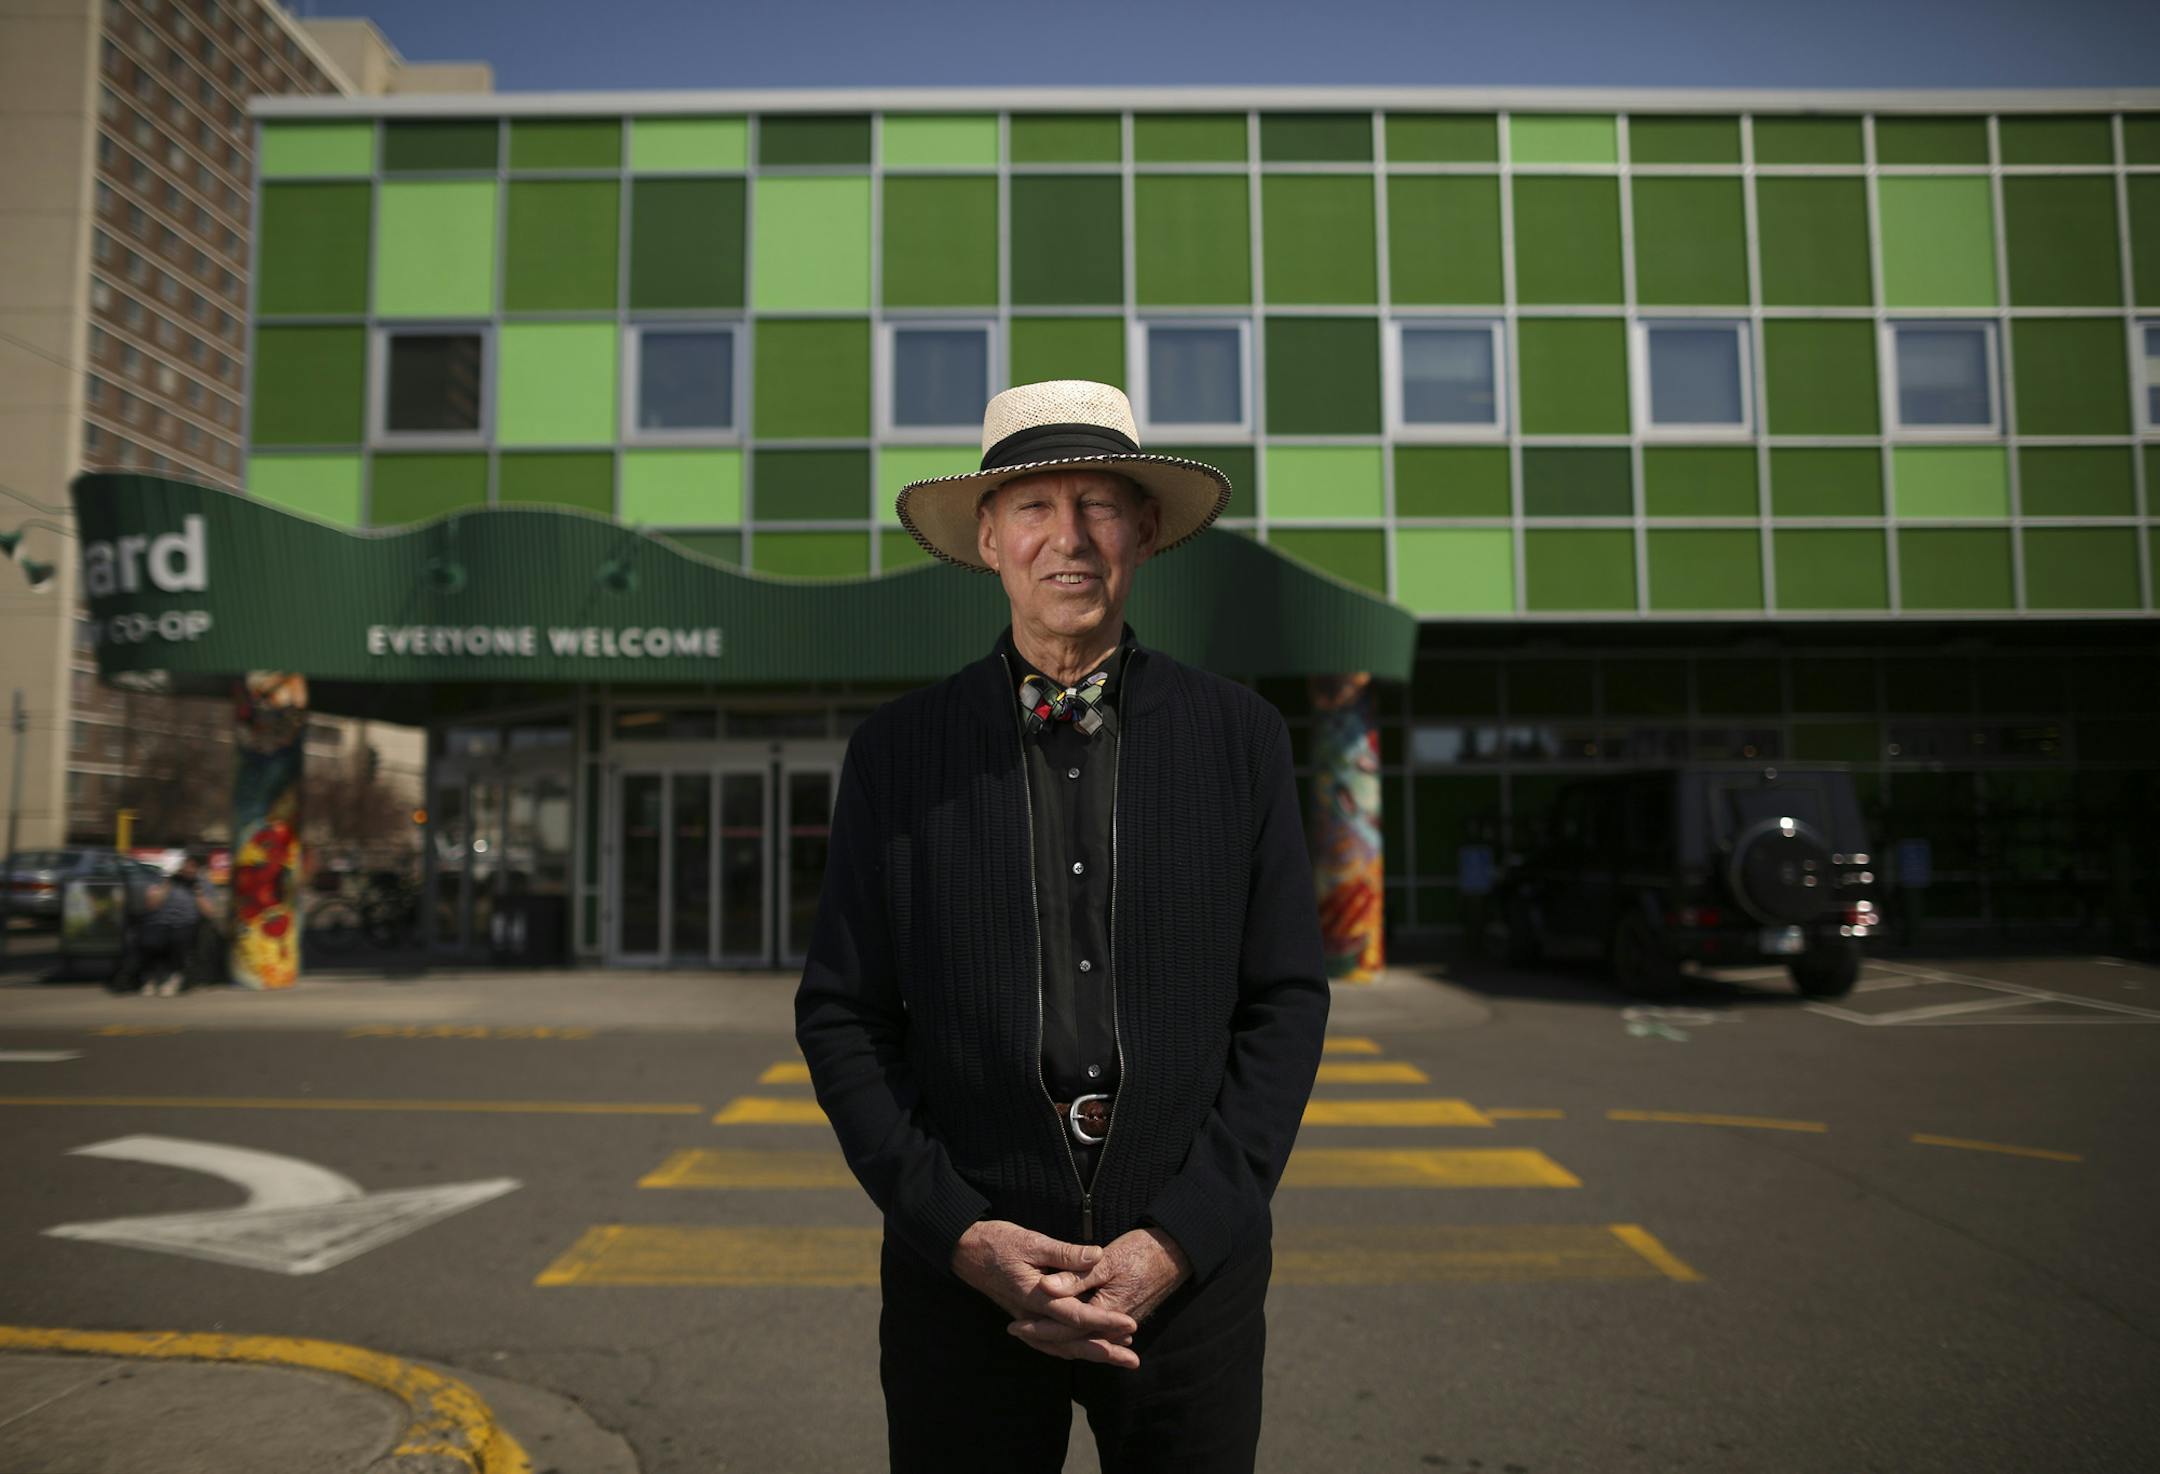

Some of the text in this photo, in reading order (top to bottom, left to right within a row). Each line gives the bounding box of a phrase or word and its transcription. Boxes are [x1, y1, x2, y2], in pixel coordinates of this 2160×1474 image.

[86, 513, 208, 597] ard
[108, 610, 213, 644] CO-OP
[367, 625, 722, 658] EVERYONE WELCOME
